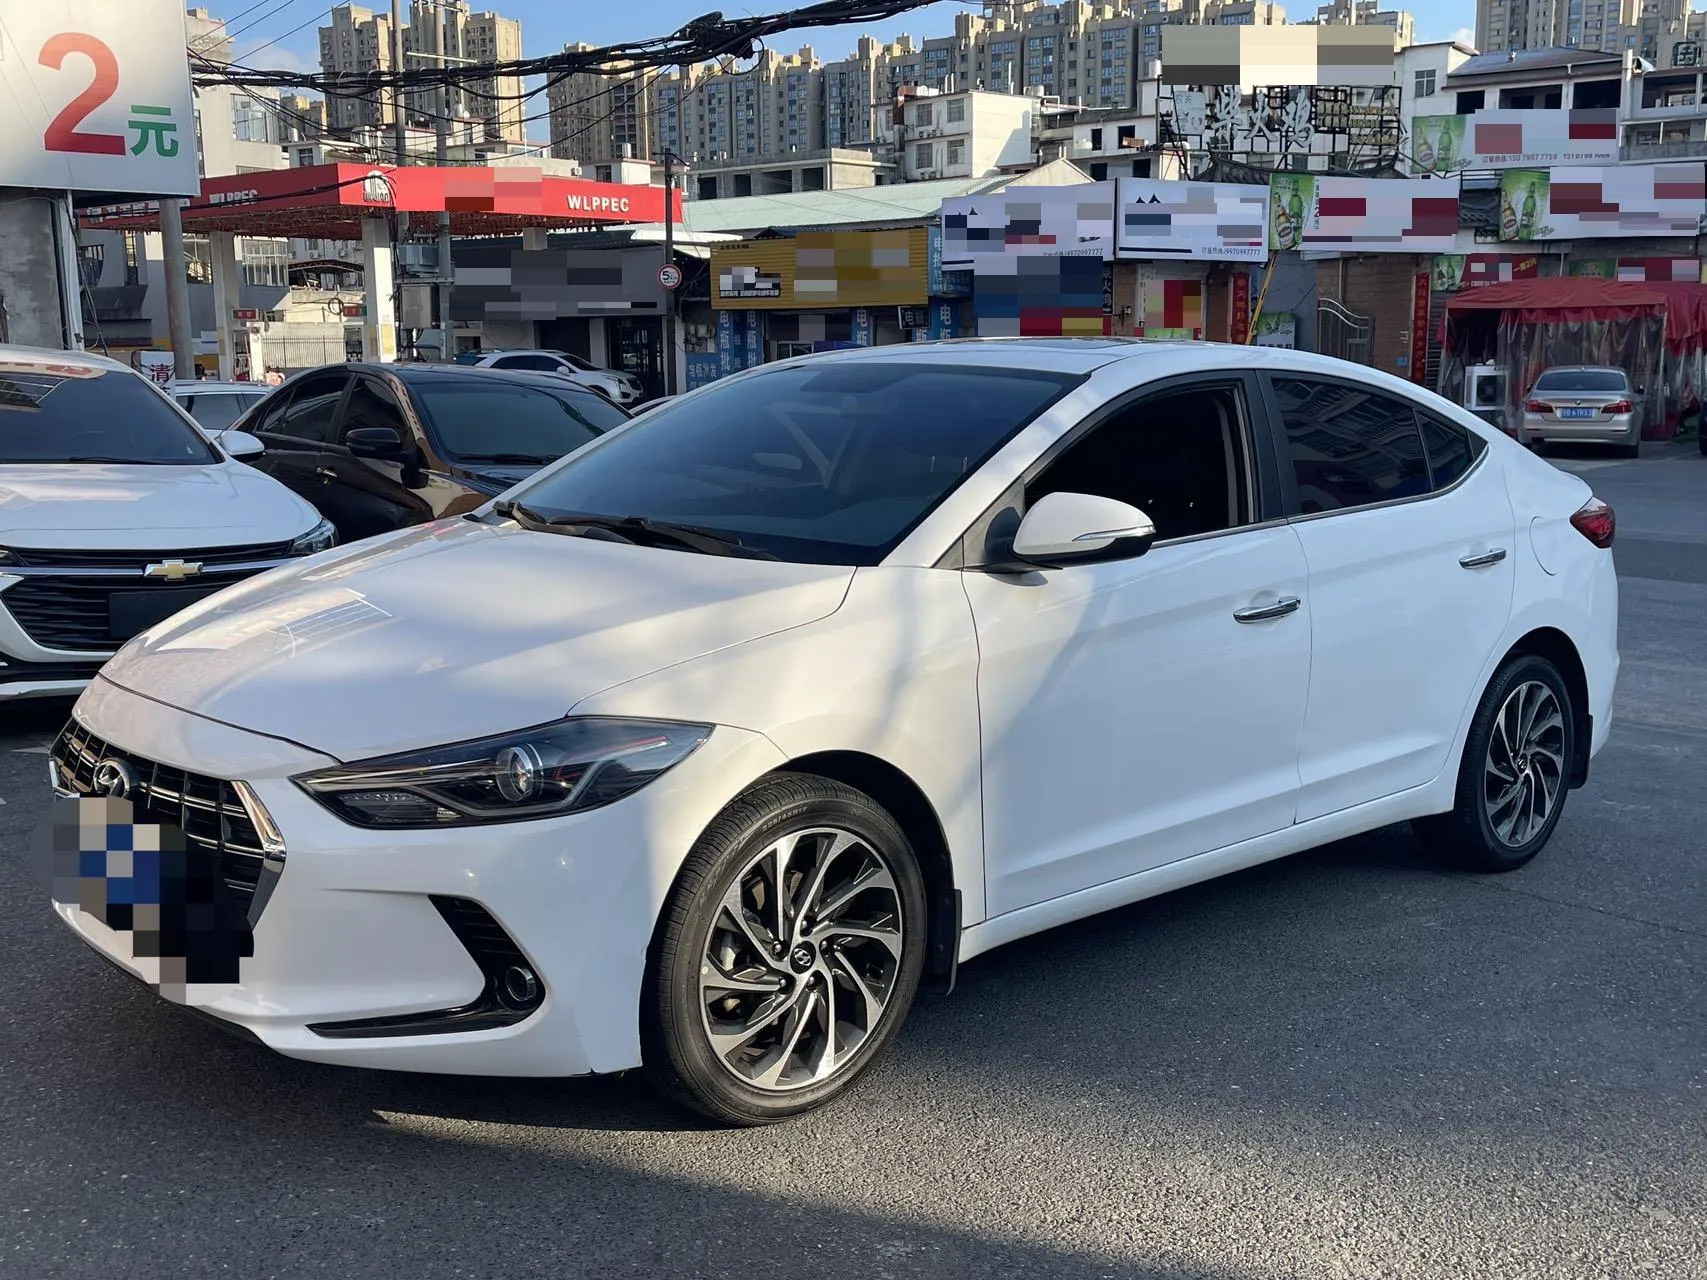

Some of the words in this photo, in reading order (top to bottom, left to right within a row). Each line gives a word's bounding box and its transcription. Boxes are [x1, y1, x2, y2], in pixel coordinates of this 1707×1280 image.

[38, 31, 179, 158] 2元
[567, 194, 630, 213] WLPPEC
[719, 310, 731, 378] 电瓶批
